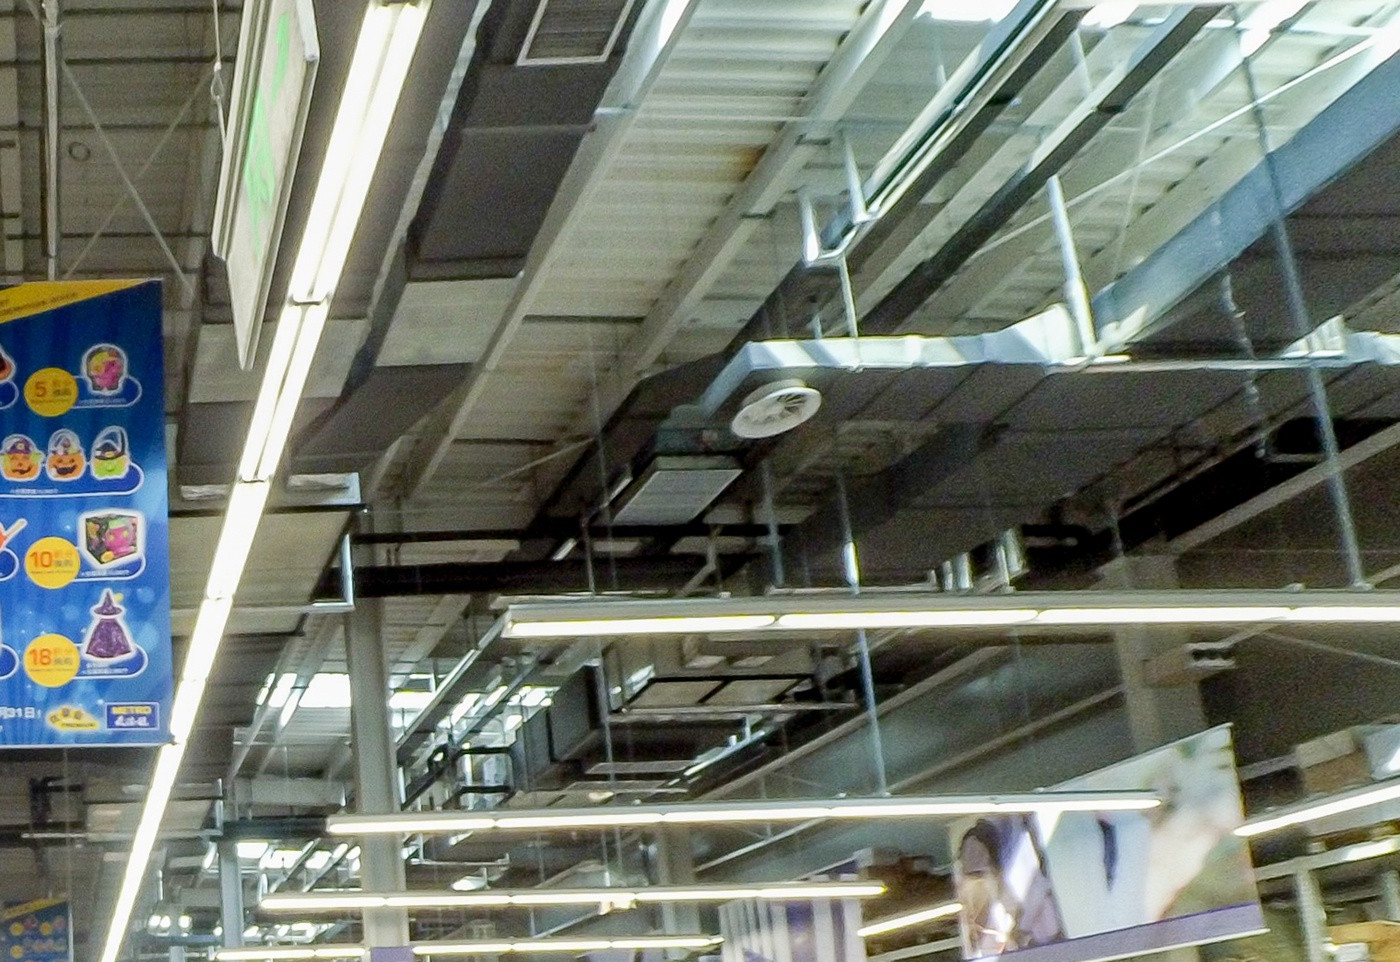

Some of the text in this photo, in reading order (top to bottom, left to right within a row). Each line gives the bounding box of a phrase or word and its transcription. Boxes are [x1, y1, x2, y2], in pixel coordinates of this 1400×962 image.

[35, 381, 46, 397] 5
[30, 551, 52, 567] 10
[29, 648, 51, 665] 18
